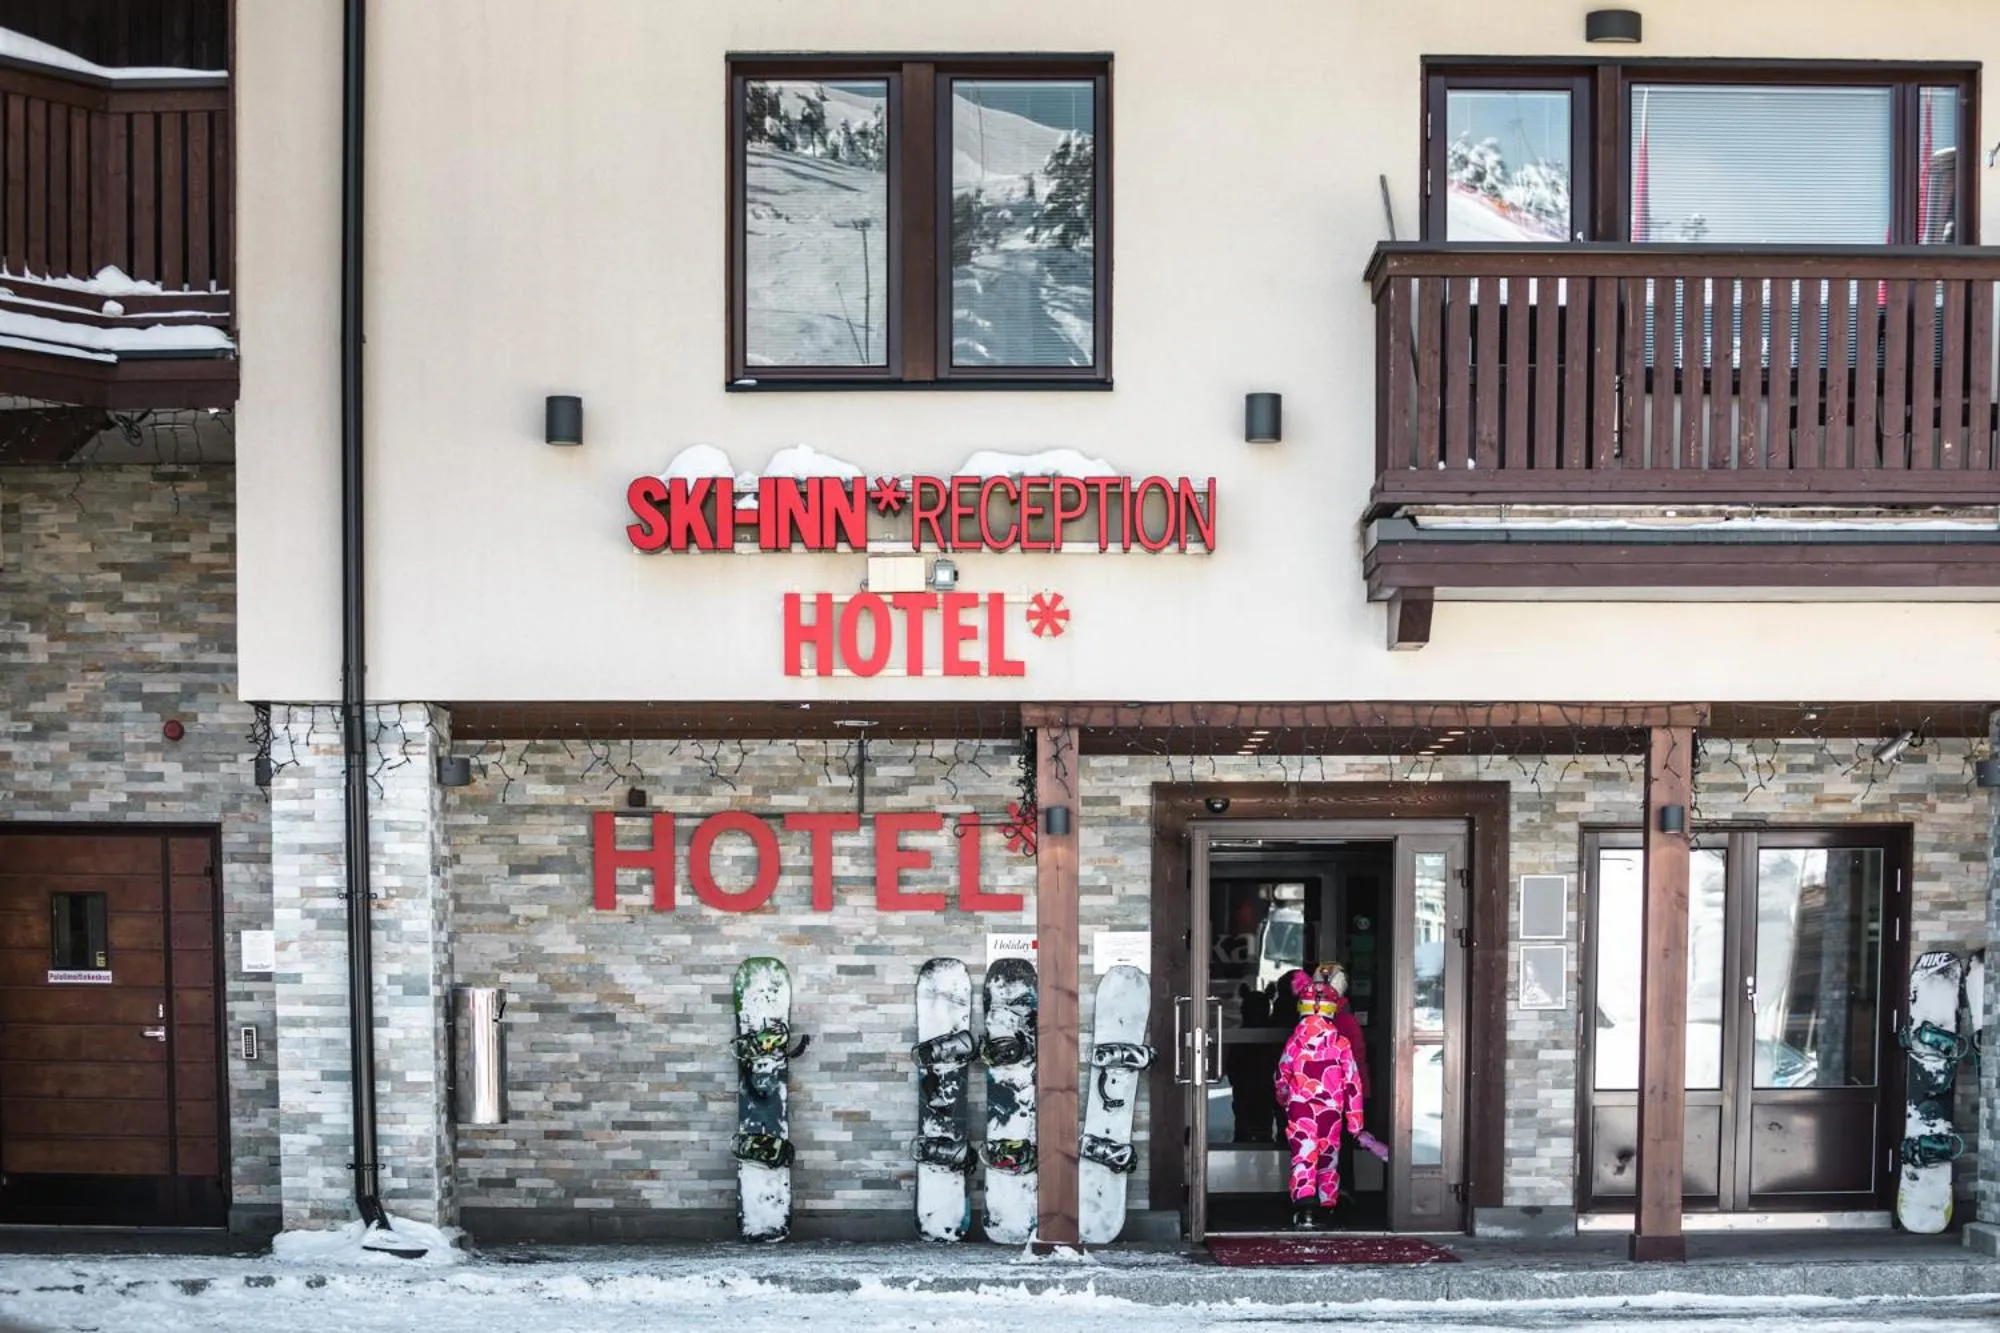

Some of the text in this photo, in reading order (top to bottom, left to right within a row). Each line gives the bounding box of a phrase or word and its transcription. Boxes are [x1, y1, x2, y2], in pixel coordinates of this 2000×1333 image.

[912, 475, 1216, 552] RECEPTION
[993, 938, 1030, 952] Holiday
[1917, 952, 1951, 967] NIKE
